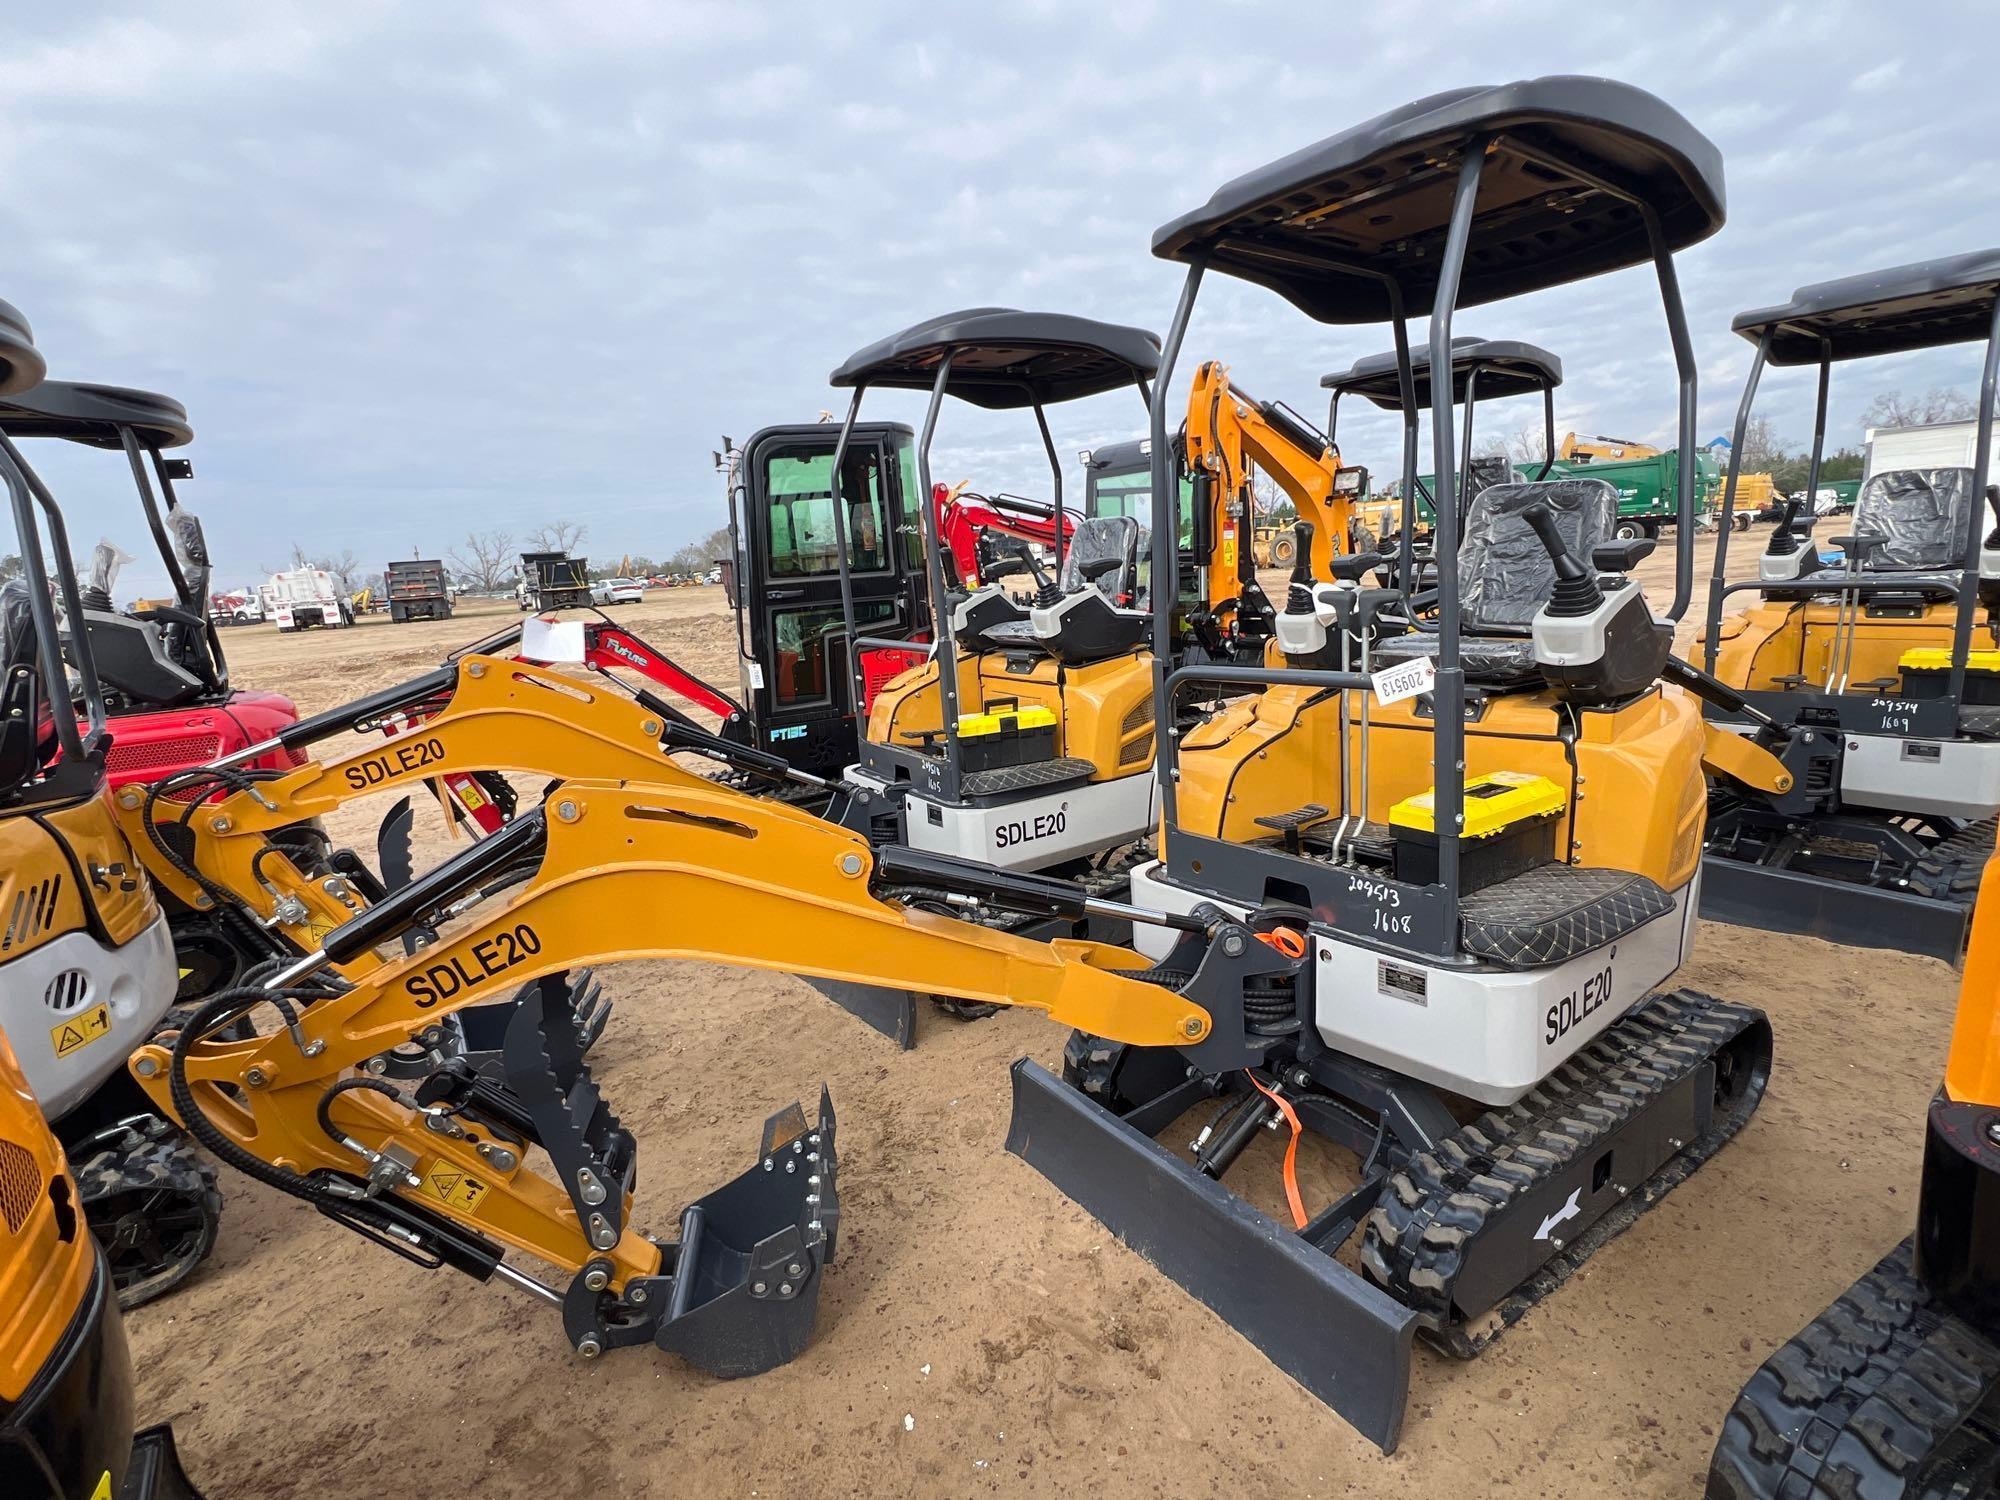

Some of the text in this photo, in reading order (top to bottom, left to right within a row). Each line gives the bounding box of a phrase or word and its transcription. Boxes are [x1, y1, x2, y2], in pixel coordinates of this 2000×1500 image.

[1382, 671, 1424, 697] 209513
[1881, 715, 1909, 732] 1609
[345, 738, 445, 790] SDLE20
[995, 811, 1066, 849] SDLE20
[1348, 875, 1401, 908] 209513
[1373, 908, 1412, 934] 1608
[405, 924, 542, 1009] SDLE20
[1545, 966, 1612, 1046] SDLE20
